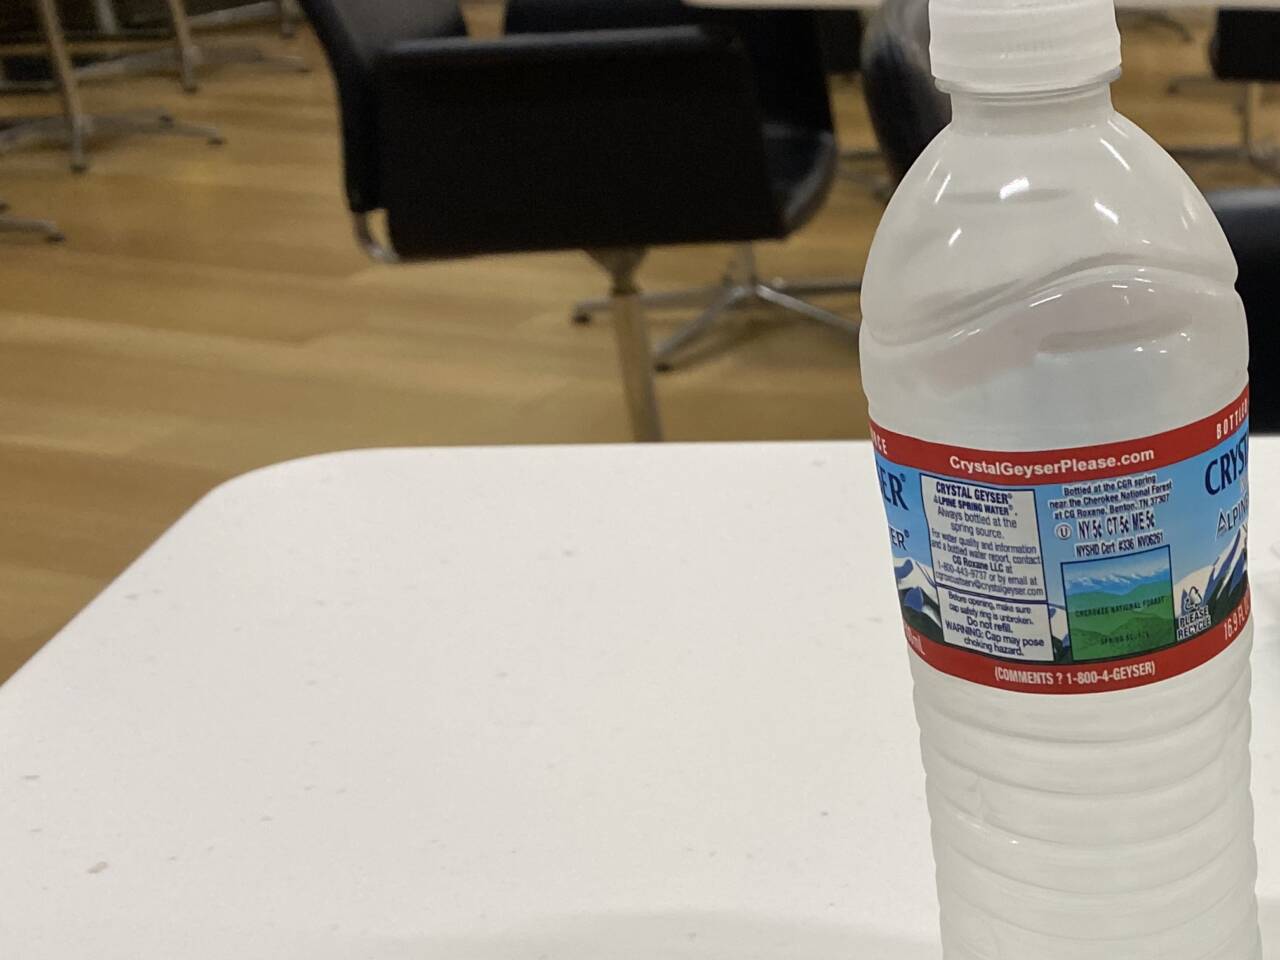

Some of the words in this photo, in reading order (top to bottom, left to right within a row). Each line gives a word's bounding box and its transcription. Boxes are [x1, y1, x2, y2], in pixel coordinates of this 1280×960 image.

[949, 449, 1154, 478] CrystalGeyserPlease.com
[936, 481, 972, 499] CRYSTAL
[1049, 499, 1067, 510] near
[1069, 497, 1081, 507] the
[1083, 493, 1119, 506] Cherokee
[1121, 487, 1150, 500] National
[1151, 480, 1172, 494] Forest
[1064, 485, 1091, 497] Bottled
[1094, 484, 1101, 493] at
[1103, 481, 1115, 492] the
[1134, 474, 1156, 487] spring
[934, 495, 957, 508] ALPINE
[958, 499, 983, 512] SPRING
[1064, 509, 1075, 519] CG
[1139, 498, 1149, 509] TN
[938, 507, 963, 521] Always
[965, 511, 990, 525] bottled
[992, 516, 1001, 527] at
[1003, 518, 1017, 529] the
[1078, 519, 1091, 540] NY
[1106, 516, 1117, 536] CT
[1131, 512, 1144, 531] ME
[950, 522, 974, 536] spring
[975, 526, 1005, 539] source.
[959, 535, 980, 548] quality
[981, 540, 993, 551] and
[995, 542, 1037, 554] information
[952, 555, 962, 566] CG
[963, 557, 989, 570] Roxane
[990, 561, 1004, 573] LLC
[1012, 555, 1041, 565] contact
[997, 572, 1006, 583] by
[1008, 576, 1028, 585] email
[1030, 577, 1038, 586] at
[967, 616, 979, 627] Do
[980, 618, 993, 629] not
[994, 621, 1013, 633] refill.
[1179, 608, 1209, 629] PLEASE
[985, 631, 1002, 643] Cap
[1003, 636, 1020, 647] may
[1022, 638, 1045, 648] pose
[1177, 620, 1211, 641] RECYCLE
[994, 666, 1054, 685] (COMMENTS
[1066, 661, 1156, 685] 1-800-4-GEYSER)
